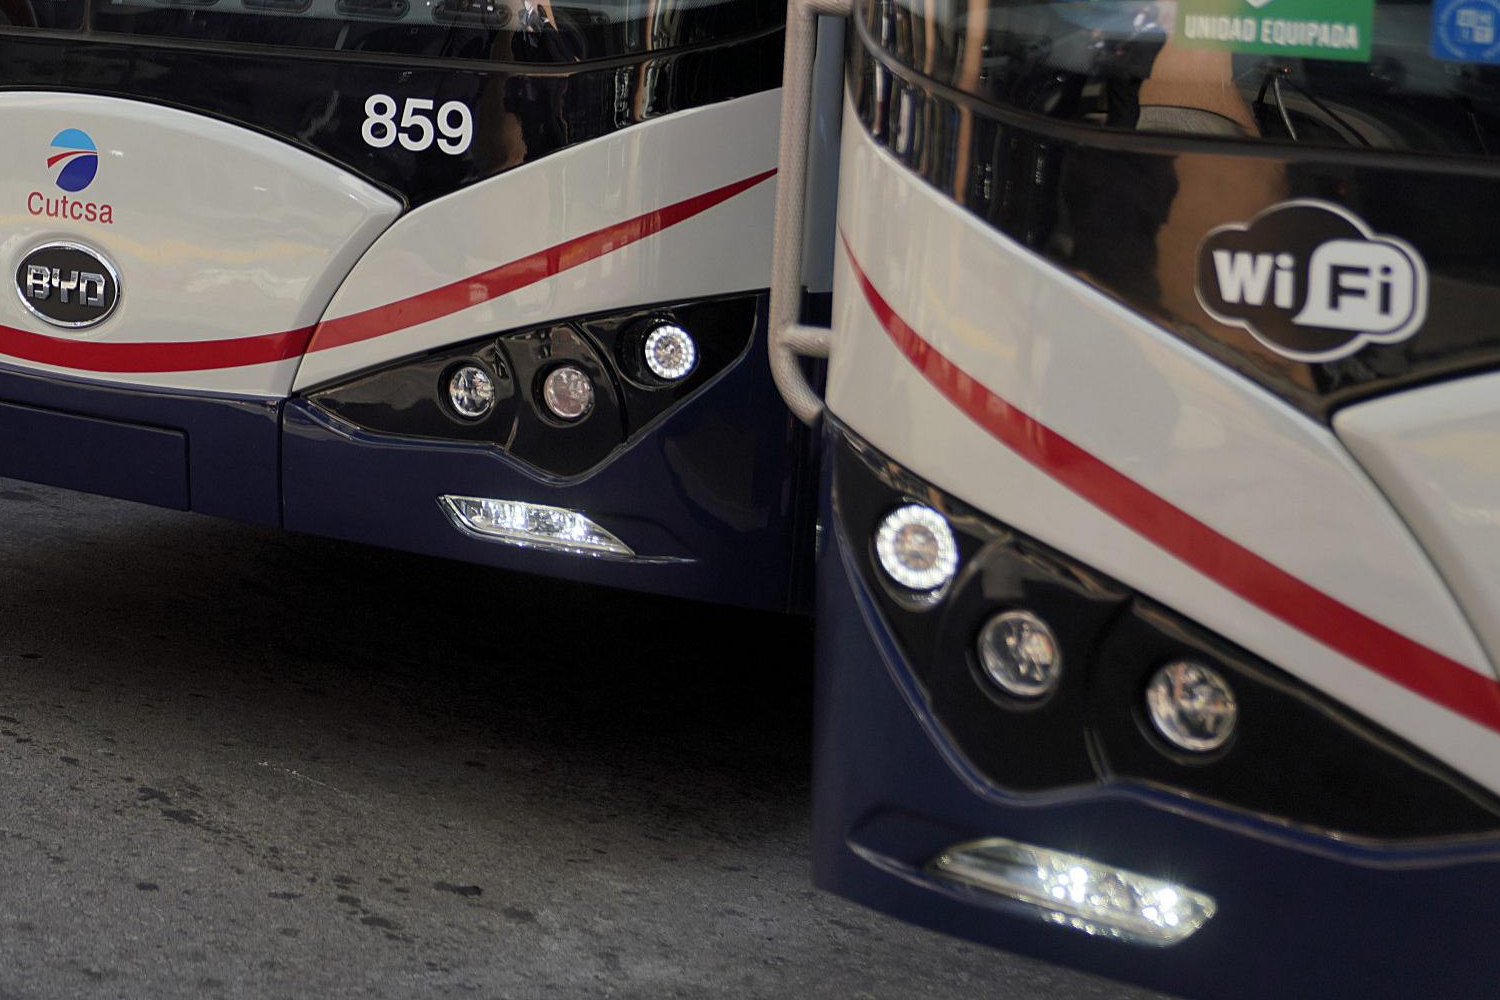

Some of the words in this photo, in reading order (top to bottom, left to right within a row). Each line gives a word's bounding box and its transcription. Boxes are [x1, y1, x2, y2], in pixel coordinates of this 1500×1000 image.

[1184, 14, 1257, 43] UNIDAD
[1260, 18, 1360, 49] EQUIPADA
[361, 93, 474, 156] 859
[27, 191, 114, 225] Cutcsa
[26, 264, 106, 308] BYD
